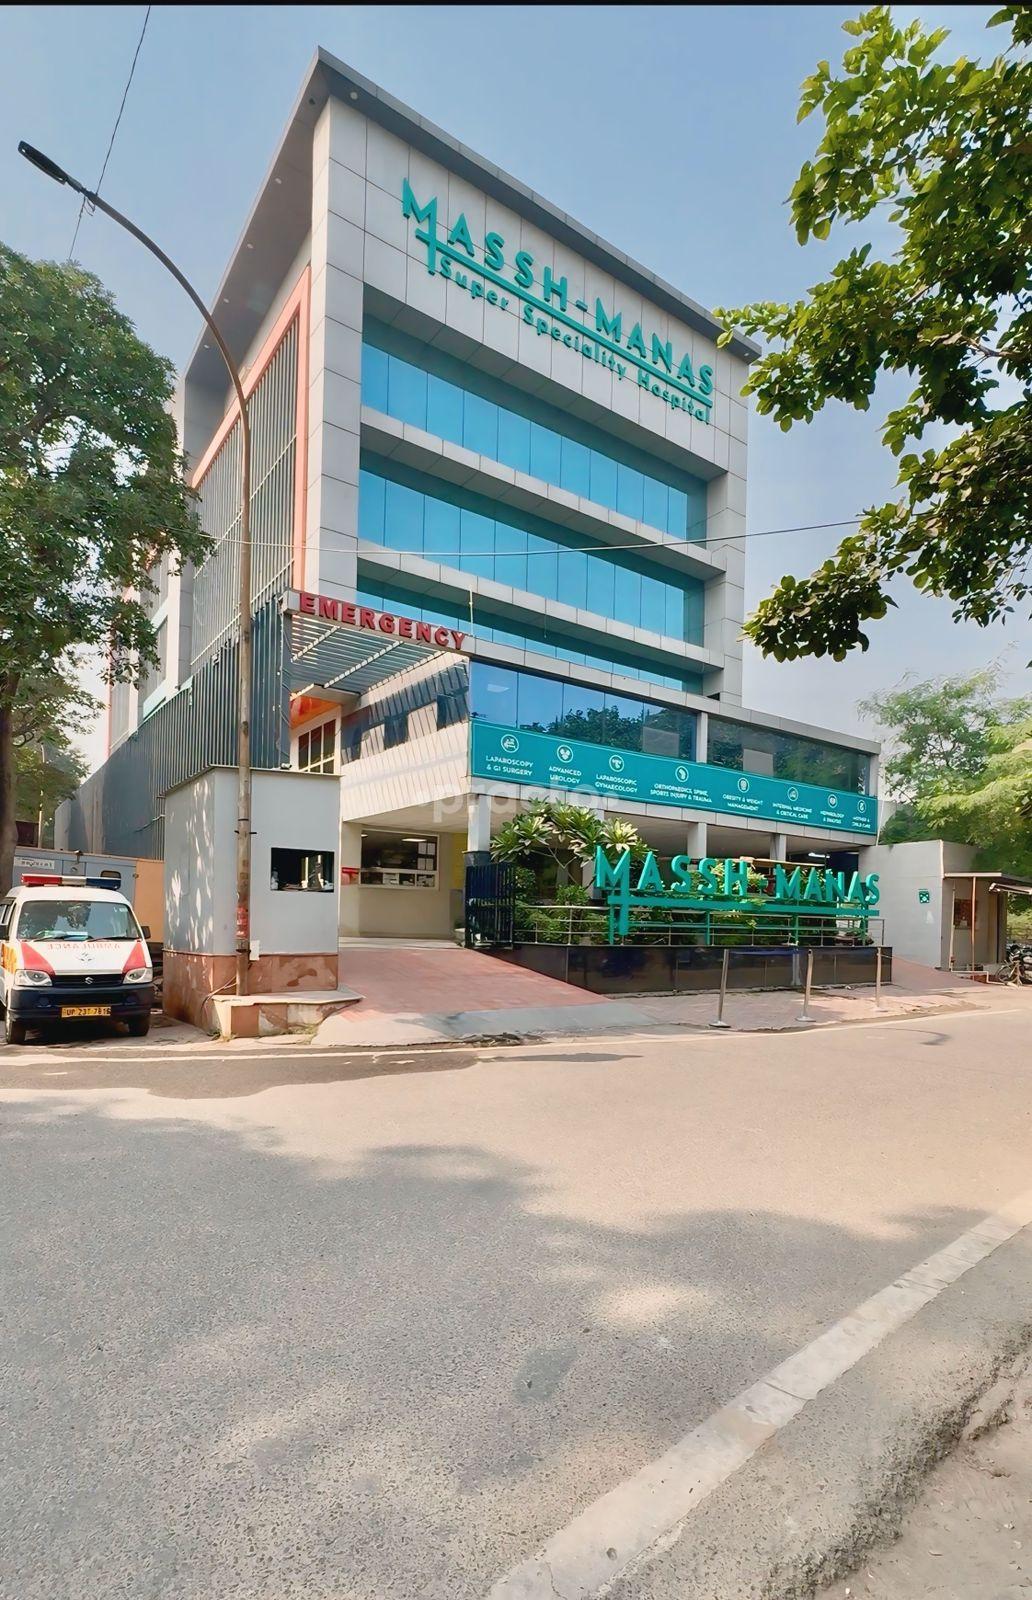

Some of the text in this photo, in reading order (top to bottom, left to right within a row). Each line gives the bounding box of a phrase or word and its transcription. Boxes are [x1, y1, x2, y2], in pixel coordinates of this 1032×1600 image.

[439, 256, 711, 425] Super Speciality Hospital
[299, 592, 466, 651] EMERGENCY
[485, 755, 534, 768] LAPAROSCOPY
[502, 766, 533, 776] SURGERY
[548, 766, 582, 776] ADVANCED
[549, 774, 580, 784] UROLOGY
[595, 774, 638, 786] LAPAROSCOPIC
[594, 781, 638, 793] GYNAECOLOGY
[650, 789, 670, 797] SPORTS
[670, 791, 688, 799] INJURY
[692, 794, 713, 803] TRAUMA
[722, 794, 741, 802] OBESITY
[746, 798, 764, 806] WEIGHT
[727, 802, 759, 811] MANAGEMENT
[772, 802, 813, 814] INTERNAL MEDICINE
[780, 810, 797, 818] CRITICAL
[66, 1008, 76, 1016] UP
